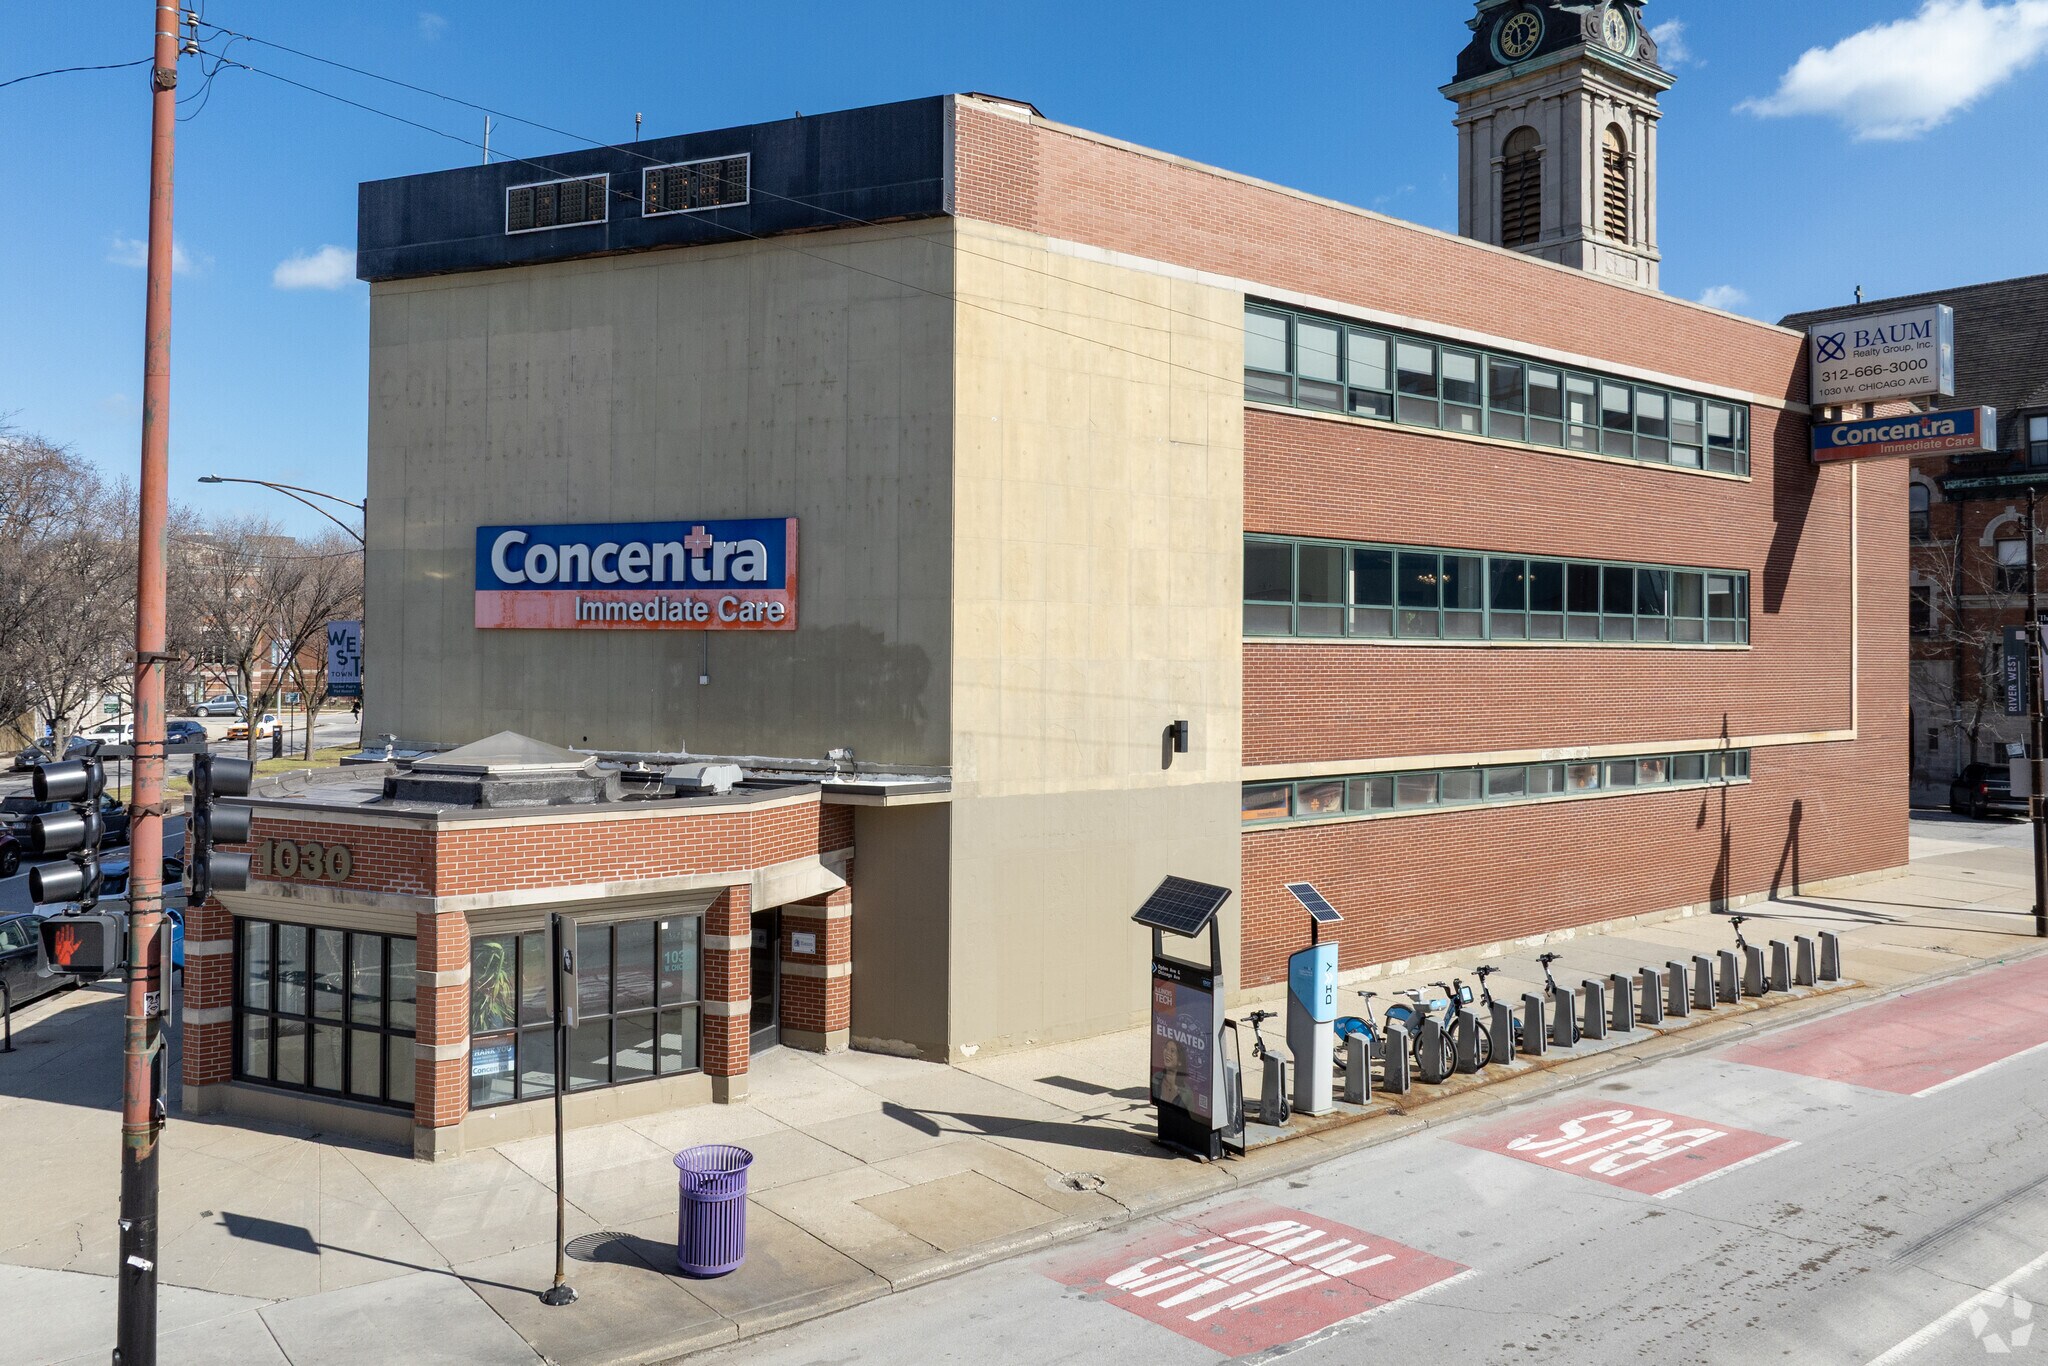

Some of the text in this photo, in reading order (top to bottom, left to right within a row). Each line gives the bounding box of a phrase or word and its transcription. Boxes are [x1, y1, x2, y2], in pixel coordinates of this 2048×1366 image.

[1853, 319, 1932, 349] BAUM
[1853, 340, 1933, 358] Realty Group, Inc.
[1822, 358, 1928, 382] 312-666-3000
[1819, 376, 1932, 396] 1030 W. CHICAGO AVE.
[1831, 416, 1955, 446] Concentra
[1880, 436, 1975, 454] Immediate Care
[491, 525, 768, 585] Concentra
[575, 595, 785, 623] Immediate Care
[328, 629, 361, 677] WEST
[2008, 655, 2018, 712] RIVER WEST
[257, 838, 353, 882] 1030
[1155, 993, 1173, 1006] TECH
[1156, 1024, 1205, 1051] ELEVATED
[1507, 1109, 1728, 1177] BUS
